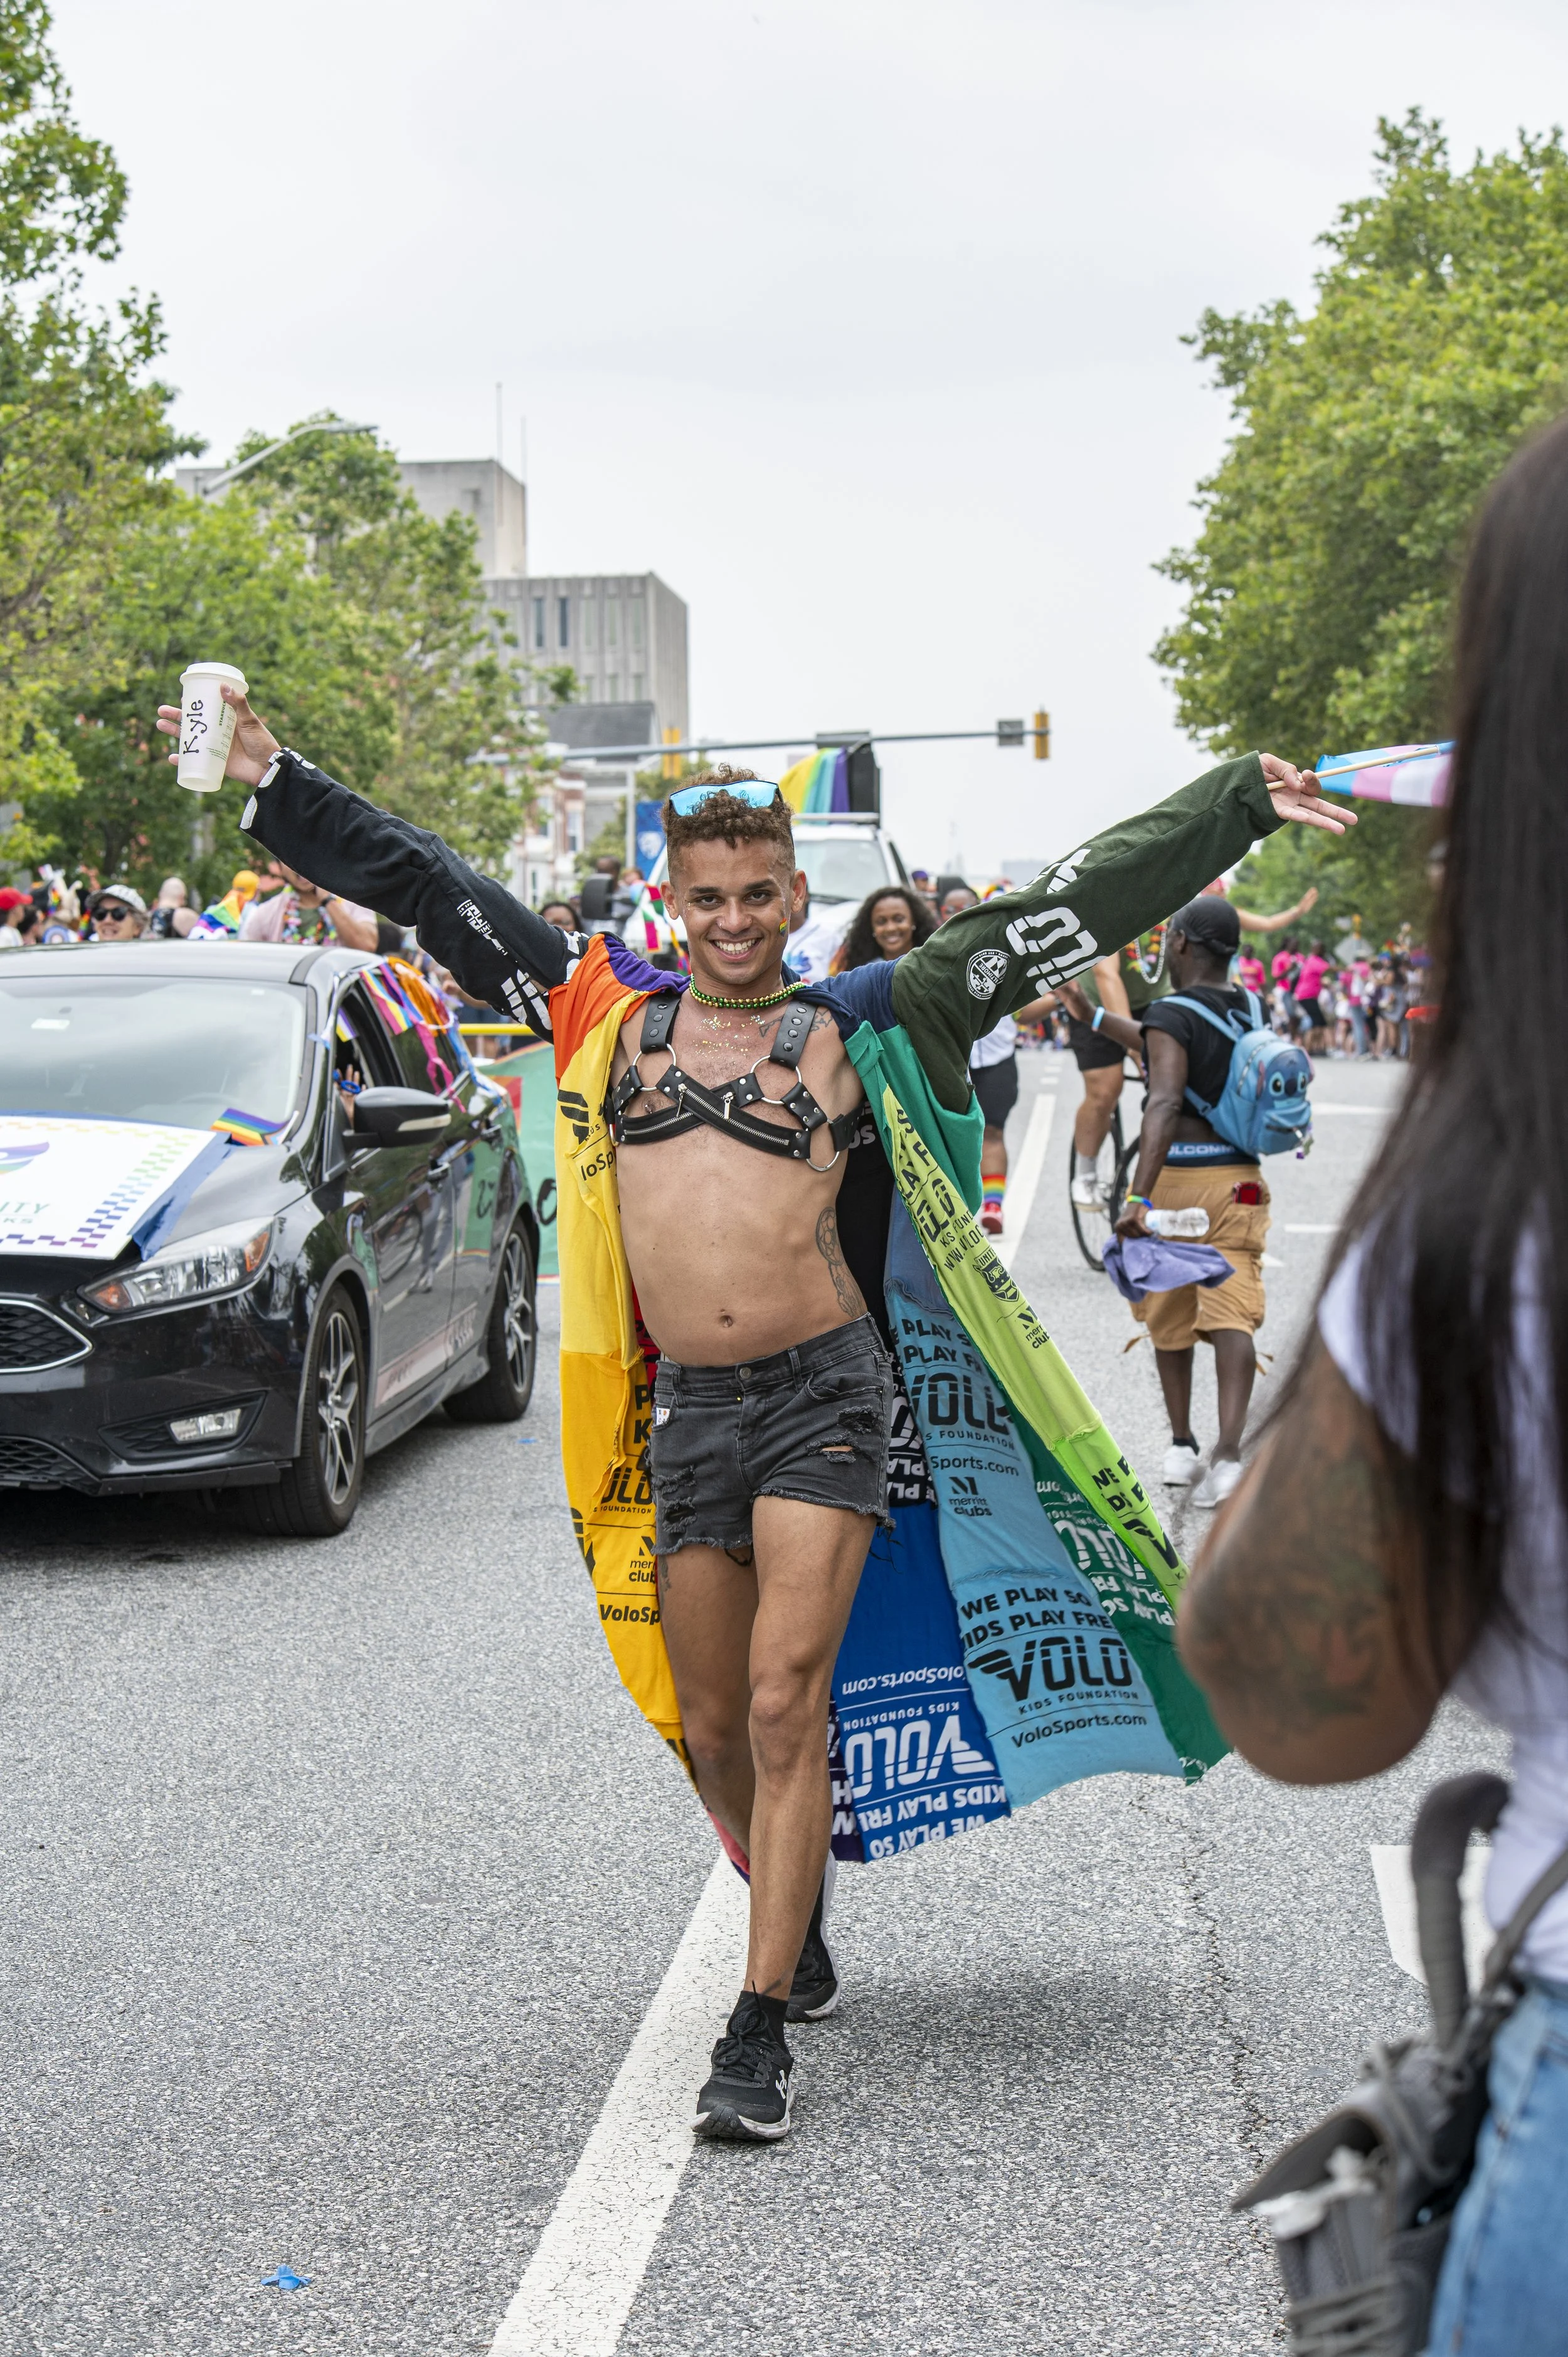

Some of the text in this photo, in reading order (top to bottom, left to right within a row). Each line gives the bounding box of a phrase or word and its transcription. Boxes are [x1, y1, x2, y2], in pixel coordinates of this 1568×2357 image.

[183, 700, 208, 755] Kyle
[978, 962, 999, 983] ALTIMORE
[901, 1319, 951, 1341] PLAY
[1025, 1324, 1043, 1341] merr
[903, 1345, 957, 1364] PLAY
[940, 1430, 1015, 1450] FOUNDATION
[931, 1456, 1020, 1476] Sports.com
[954, 1506, 993, 1517] clubs
[630, 1560, 656, 1568] mer
[628, 1571, 656, 1583] club
[600, 1604, 661, 1625] VoloSp
[960, 1587, 1093, 1620] WE PLAY SO
[1009, 1610, 1065, 1631] PLAY
[1071, 1611, 1115, 1630] FRE
[842, 1666, 967, 1695] oloSports.com
[967, 1636, 1133, 1702] VOLO
[1019, 1690, 1139, 1715] KIDS FOUNDATION
[843, 1701, 960, 1732] KIDS FOUNDATION
[1011, 1714, 1147, 1748] VoloSports.com
[845, 1715, 995, 1799] VOLO
[898, 1792, 949, 1821] PLAY
[953, 1785, 1007, 1808] KIDS
[869, 1835, 895, 1859] SO
[898, 1821, 946, 1851] PLAY
